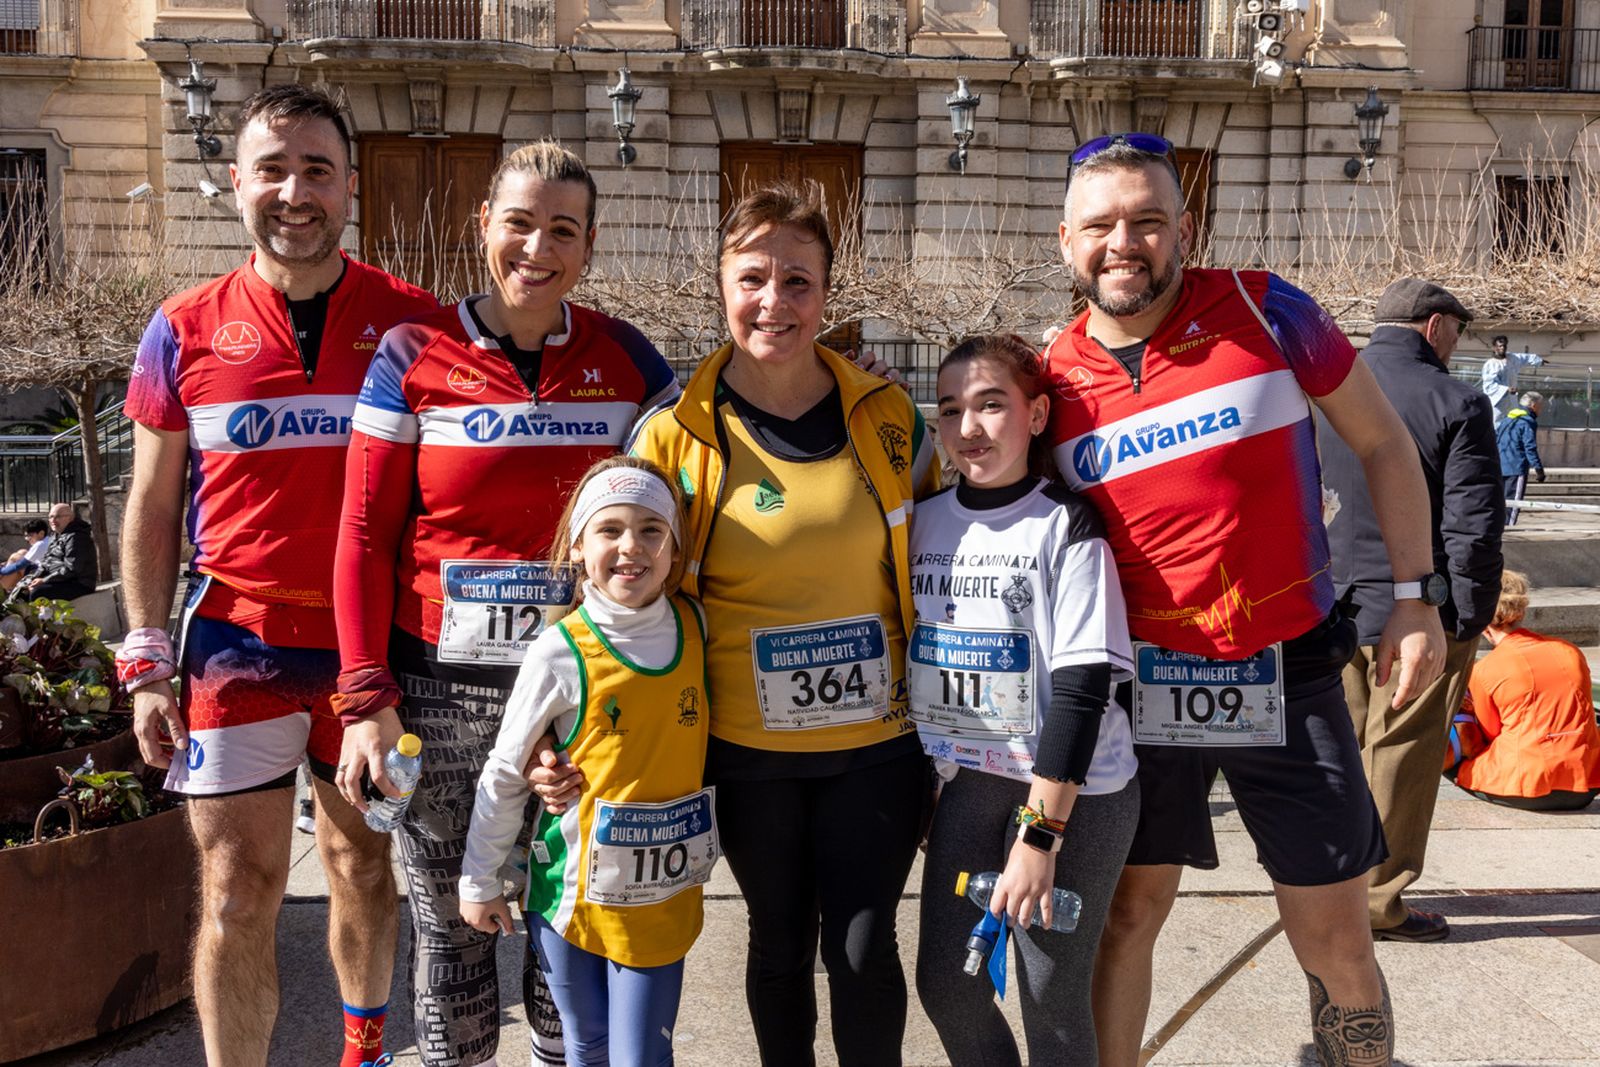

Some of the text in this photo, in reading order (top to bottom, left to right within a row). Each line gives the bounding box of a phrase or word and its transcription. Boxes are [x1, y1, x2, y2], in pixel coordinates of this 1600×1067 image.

[570, 388, 617, 397] LAURA G.
[301, 408, 326, 416] GRUPO
[507, 414, 609, 436] Avanza
[1117, 406, 1241, 463] Avanza
[1135, 422, 1161, 436] GRUPO
[911, 553, 1038, 571] CARRERA CAMINATA
[462, 570, 472, 579] VI
[474, 570, 517, 580] CARRERA
[461, 584, 547, 600] BUENA MUERTE
[938, 574, 999, 599] MUERTE
[486, 605, 541, 641] 112
[770, 626, 870, 648] VI CARRERA CAMINATA
[920, 631, 1015, 648] VI CARRERA CAMINATA
[771, 643, 856, 667] BUENA MUERTE
[918, 645, 992, 667] BUENA MUERTE
[1153, 666, 1238, 681] BUENA MUERTE
[791, 663, 868, 707] 364
[940, 669, 980, 708] 111
[1170, 687, 1244, 723] 109
[624, 812, 668, 823] CARRERA
[670, 801, 701, 820] CAMINATA
[610, 820, 688, 842] BUENA MUERTE
[633, 843, 688, 882] 110
